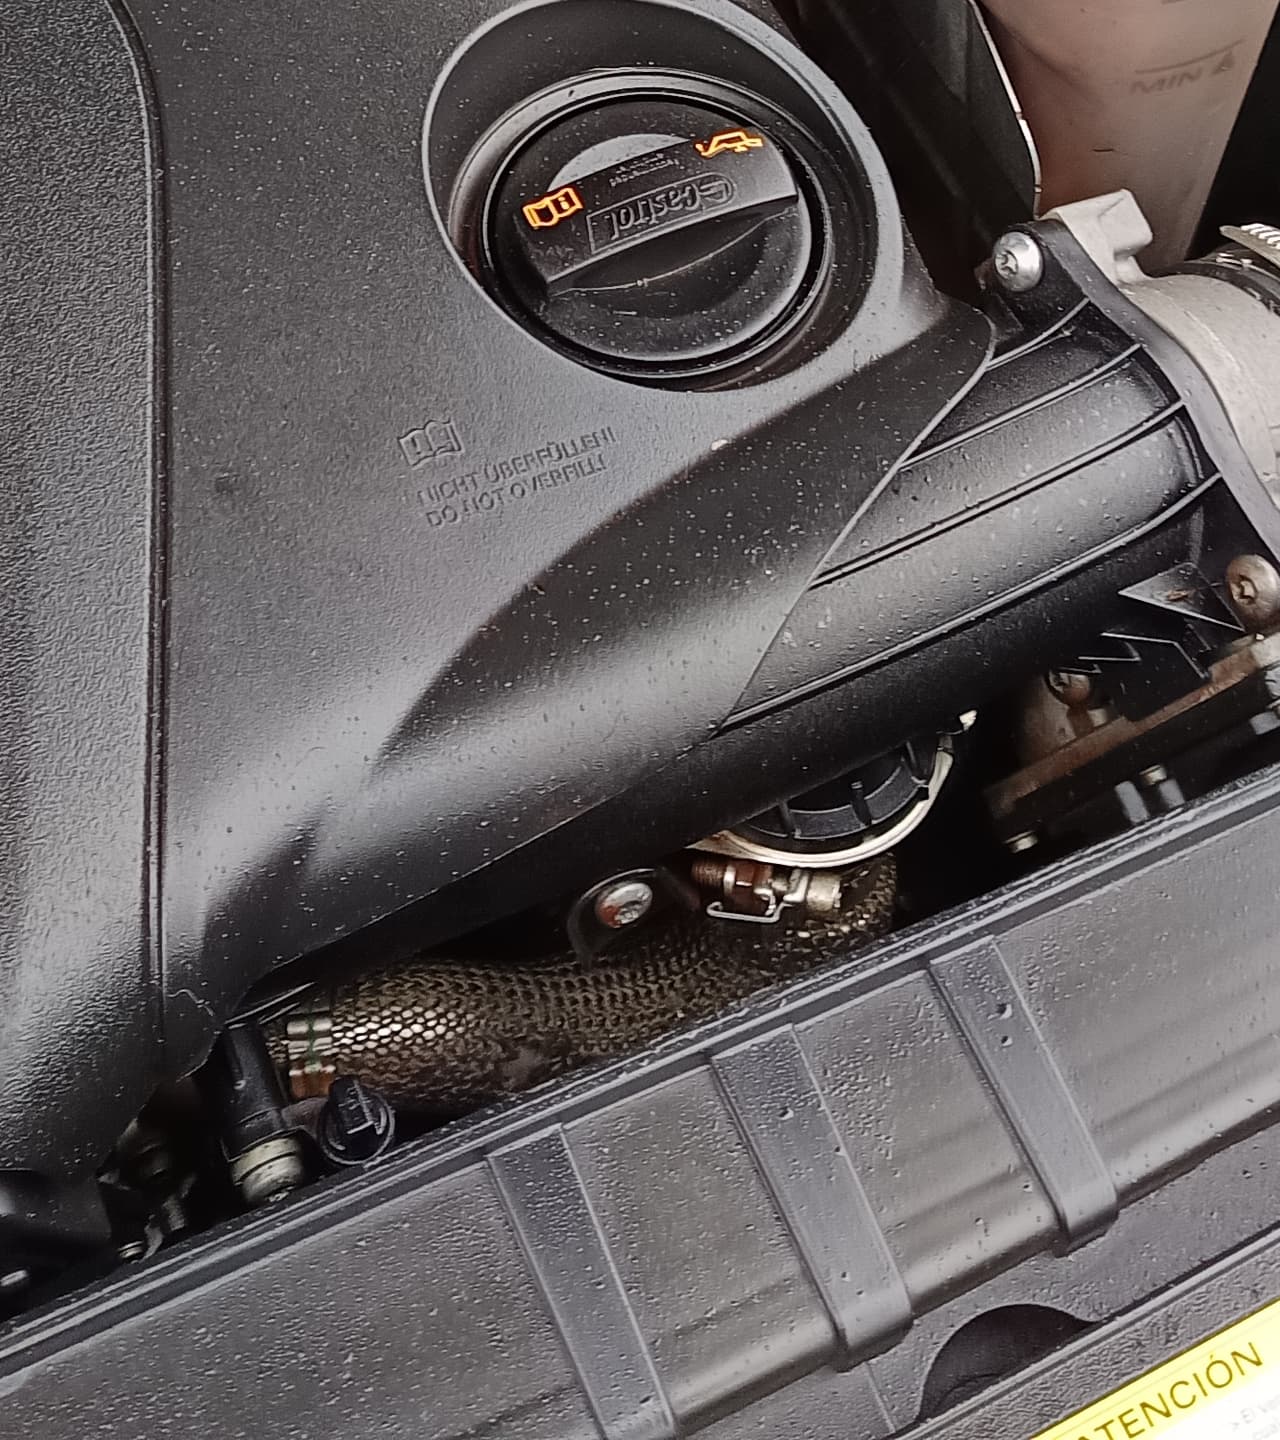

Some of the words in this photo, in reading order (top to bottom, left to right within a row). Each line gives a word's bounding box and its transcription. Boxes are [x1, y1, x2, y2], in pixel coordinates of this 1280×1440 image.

[1130, 66, 1203, 95] MIN
[611, 181, 702, 241] Castrol
[426, 504, 458, 527] DO
[1077, 1340, 1264, 1440] TENCIÓN
